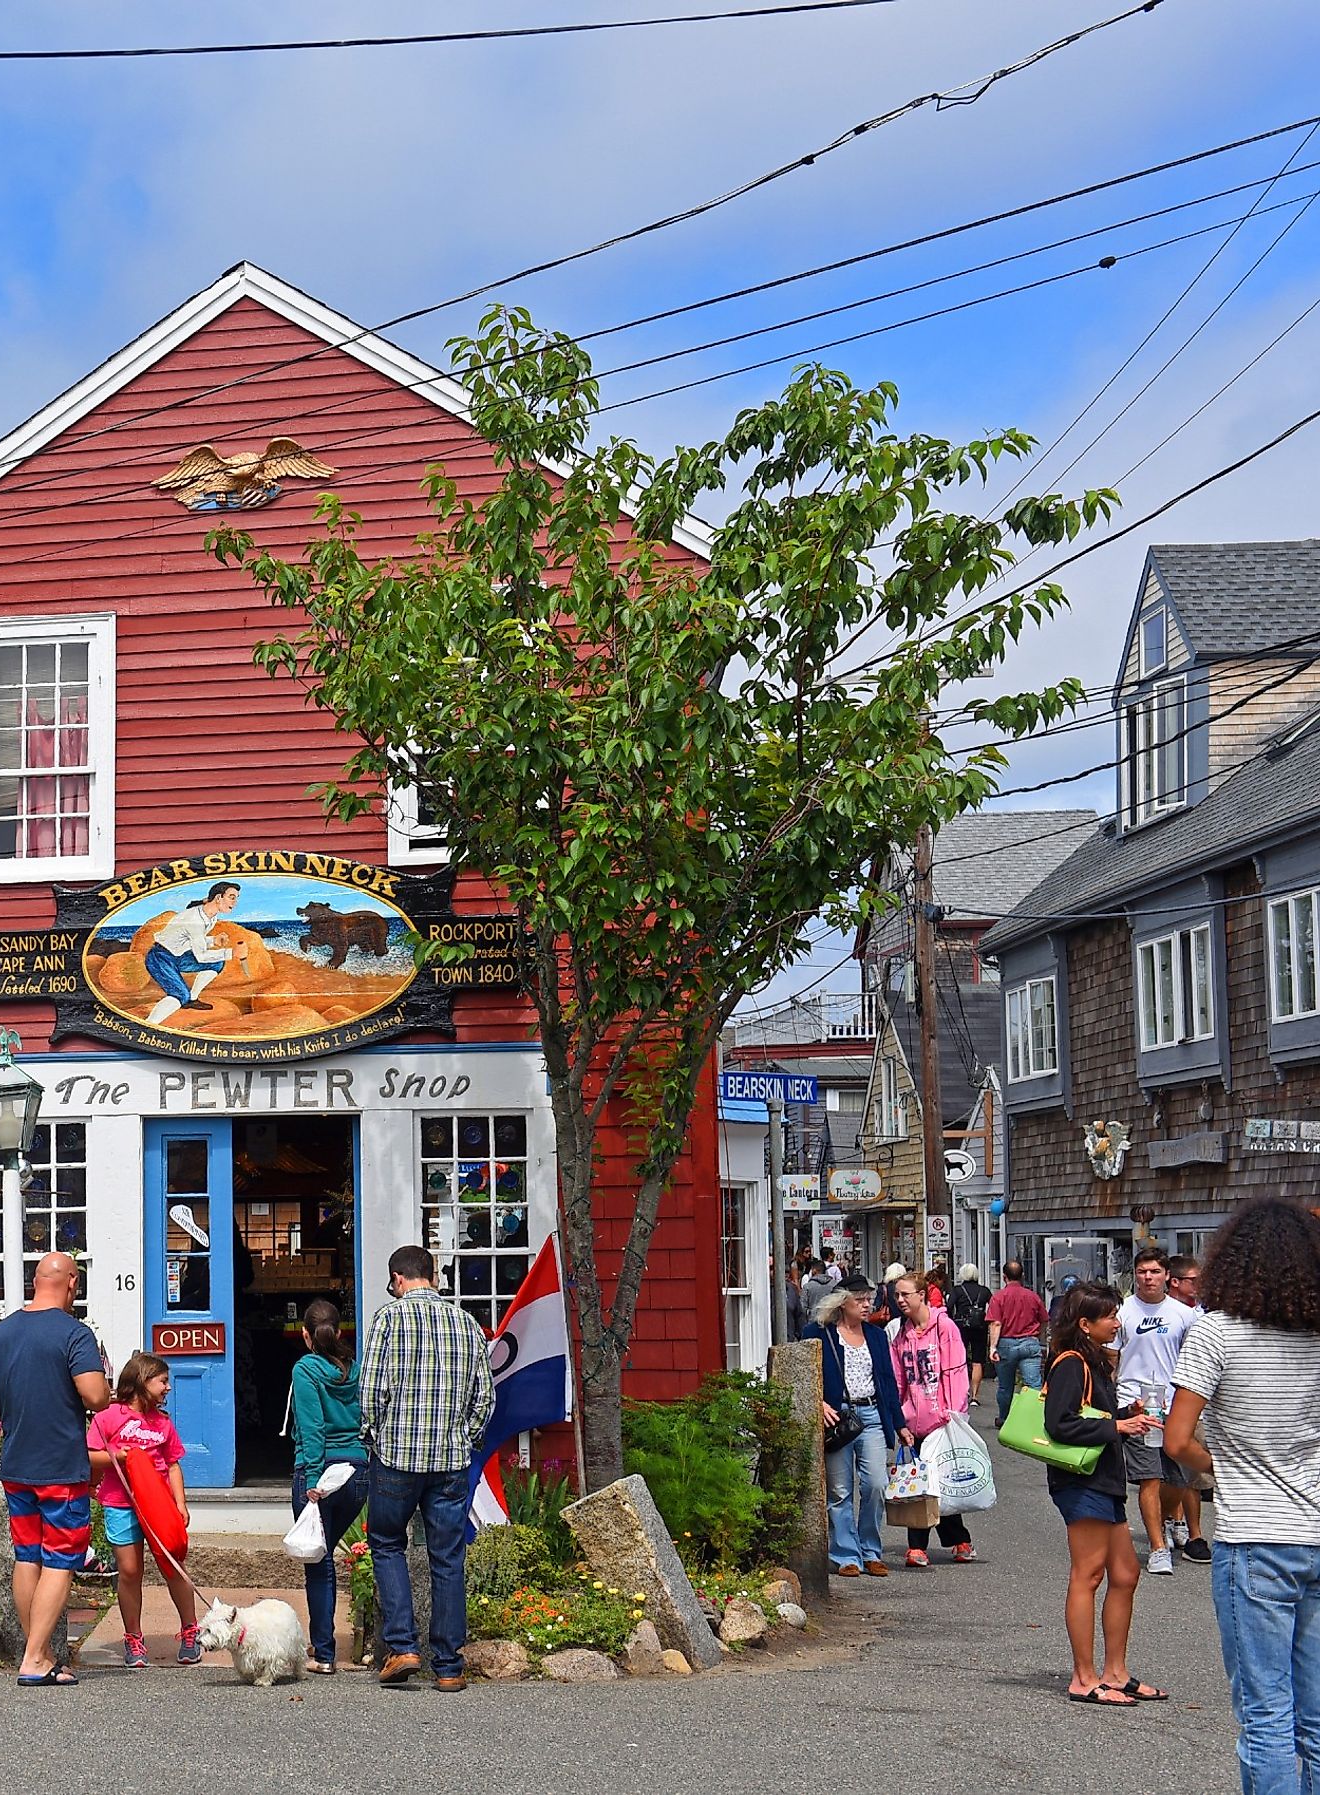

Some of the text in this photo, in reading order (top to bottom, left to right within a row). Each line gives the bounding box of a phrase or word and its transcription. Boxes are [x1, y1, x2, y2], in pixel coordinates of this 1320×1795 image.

[98, 850, 401, 910] BEAR SKIN NECK
[429, 922, 517, 942] ROCKPORT
[0, 933, 78, 953] SANDY BAY
[33, 955, 65, 972] ANN
[48, 976, 76, 993] 1690
[431, 967, 473, 984] TOWN
[137, 1031, 176, 1053] Babson,
[178, 1040, 207, 1056] Killed
[211, 1043, 228, 1058] the
[231, 1044, 259, 1060] bear,
[260, 1044, 286, 1059] with
[288, 1042, 301, 1056] his
[332, 1035, 341, 1047] I
[345, 1029, 358, 1043] do
[55, 1067, 471, 1110] The PEWTER Shop
[727, 1076, 814, 1100] BEARSKIN NECK
[789, 1186, 819, 1198] Lantern
[115, 1273, 136, 1291] 16
[1141, 1316, 1164, 1326] NIKE
[159, 1329, 219, 1349] OPEN
